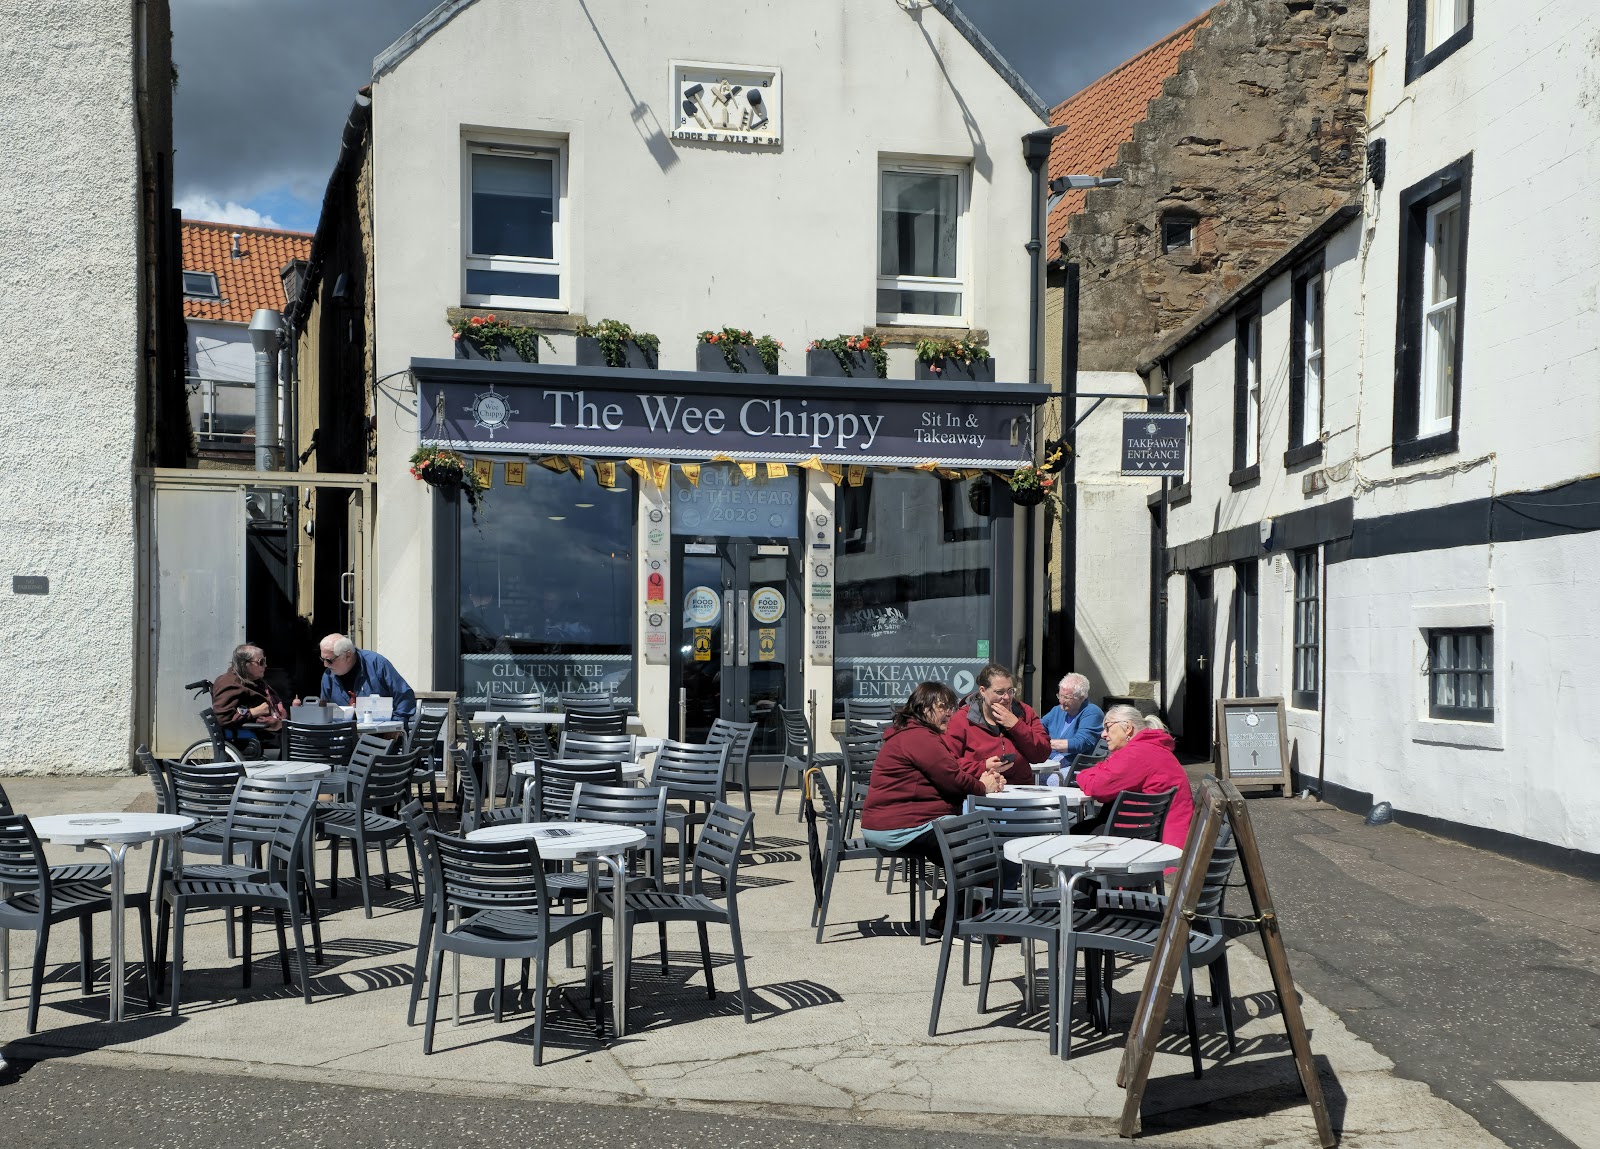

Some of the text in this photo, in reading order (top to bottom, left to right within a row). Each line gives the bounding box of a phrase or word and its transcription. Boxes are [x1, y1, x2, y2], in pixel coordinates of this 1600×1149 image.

[671, 131, 703, 140] LODGE
[723, 134, 748, 143] AYLE
[480, 409, 504, 419] Chippy
[543, 390, 885, 450] The Wee Chippy
[921, 411, 979, 428] Sit In &
[913, 428, 986, 448] Takeaway
[1127, 438, 1181, 448] TAKEAWAY
[1127, 449, 1180, 459] ENTRANCE
[677, 488, 793, 505] OF THE YEAR
[712, 507, 758, 522] 2026
[492, 663, 604, 678] GLUTEN FREE
[853, 665, 953, 681] TAKEAWAY
[476, 681, 620, 694] MENU AVAILABLE
